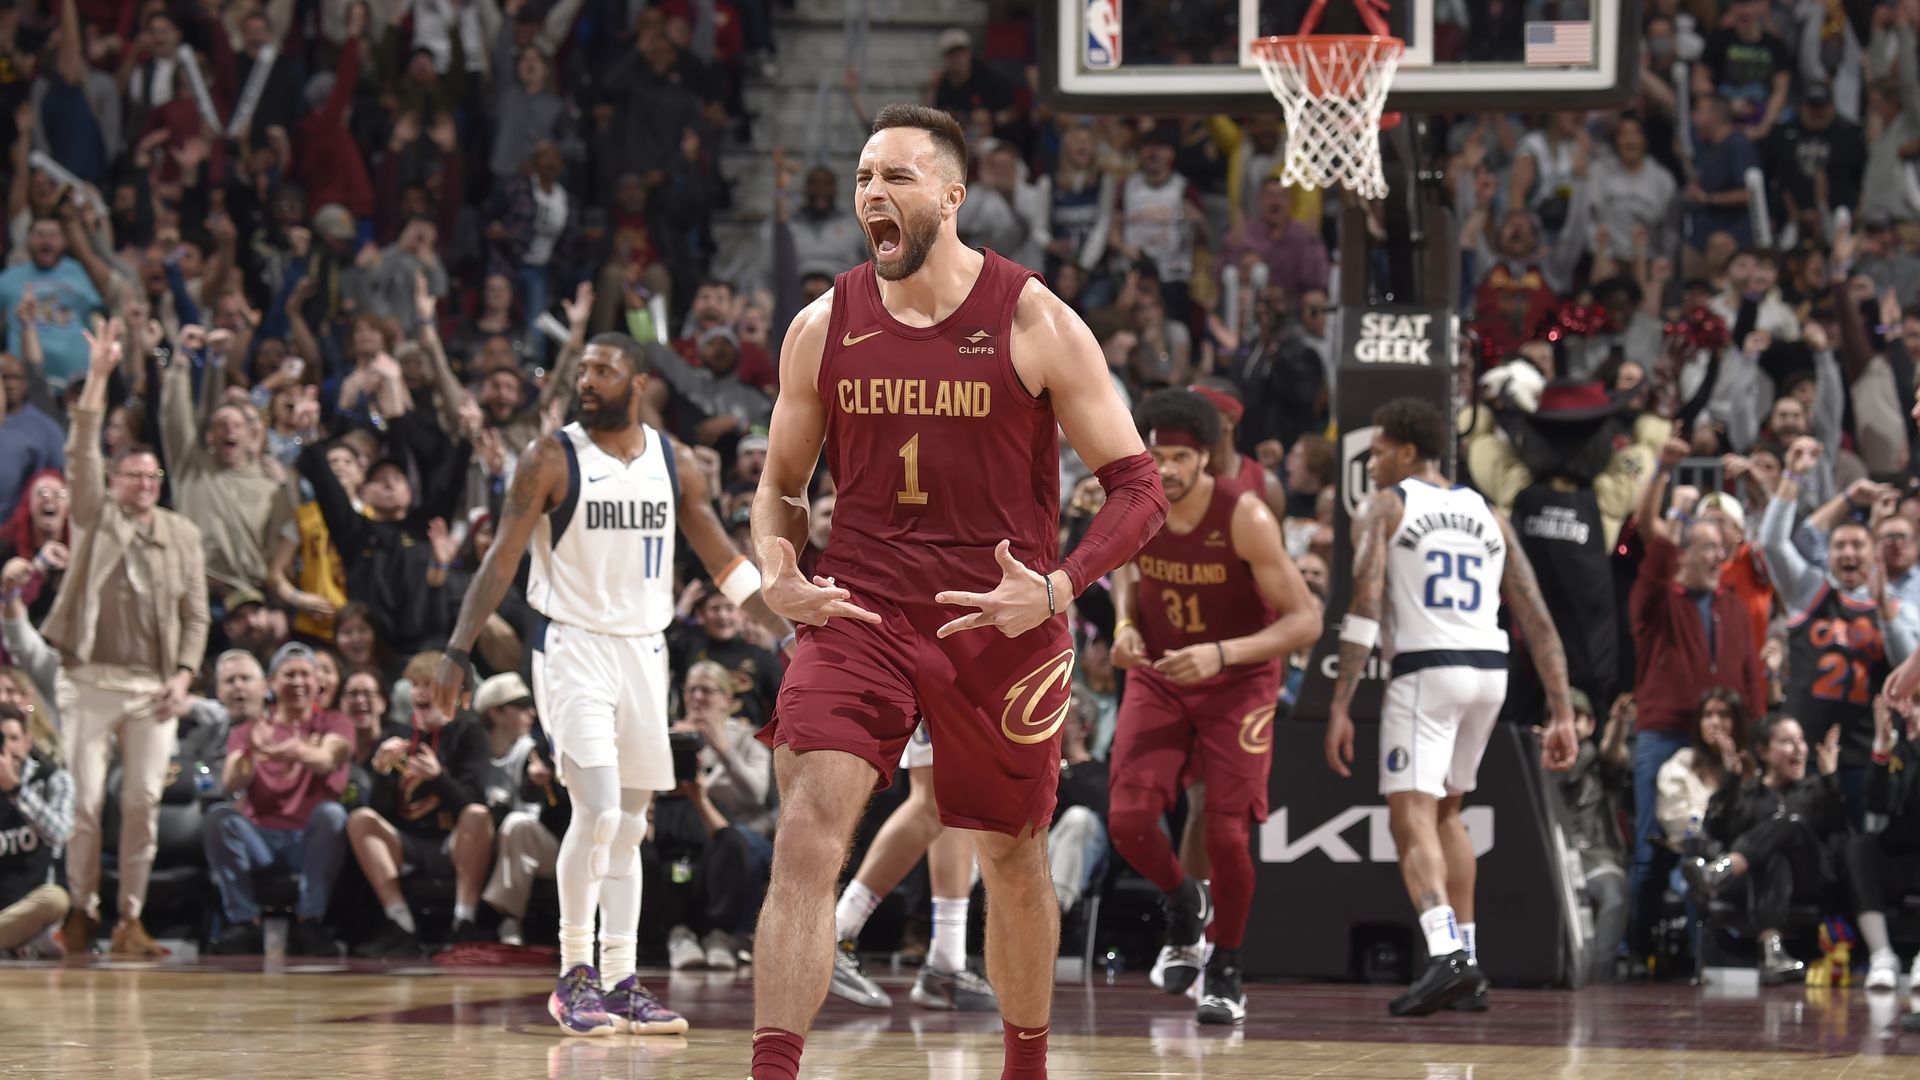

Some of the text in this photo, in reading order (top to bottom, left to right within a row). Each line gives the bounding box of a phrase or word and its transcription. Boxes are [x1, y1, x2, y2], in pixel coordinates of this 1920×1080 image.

[1361, 312, 1432, 338] SEAT
[958, 346, 995, 355] CLIFFS
[1354, 339, 1432, 366] GEEK
[837, 378, 991, 418] CLEVELAND
[897, 432, 929, 505] 1
[586, 500, 668, 530] DALLAS
[1396, 512, 1484, 552] WASHINGTON
[643, 536, 664, 579] 11
[1140, 554, 1227, 585] CLEVELAND
[1424, 549, 1482, 612] 25
[1161, 588, 1206, 633] 31
[1811, 652, 1869, 704] 21
